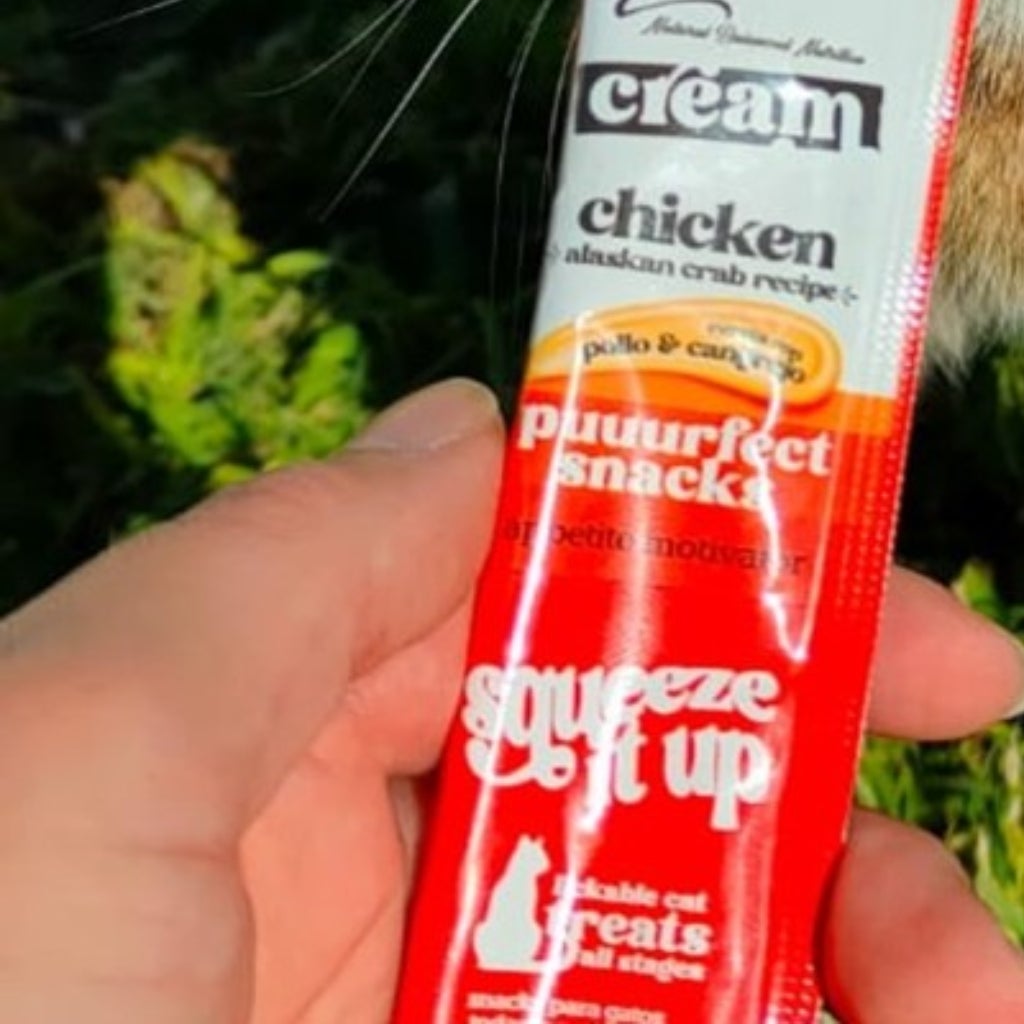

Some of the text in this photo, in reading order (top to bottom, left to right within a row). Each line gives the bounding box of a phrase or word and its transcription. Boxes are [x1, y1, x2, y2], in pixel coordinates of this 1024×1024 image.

[586, 64, 876, 151] cream
[578, 187, 837, 270] chicken
[565, 244, 838, 304] alaskan crab recipe
[583, 333, 650, 364] pollo
[657, 333, 680, 355] &
[518, 401, 833, 476] puuurfect
[554, 450, 774, 512] snacks
[461, 664, 780, 790] squeeze
[662, 725, 772, 832] up
[553, 874, 709, 914] lckable cat
[546, 906, 714, 956] treats
